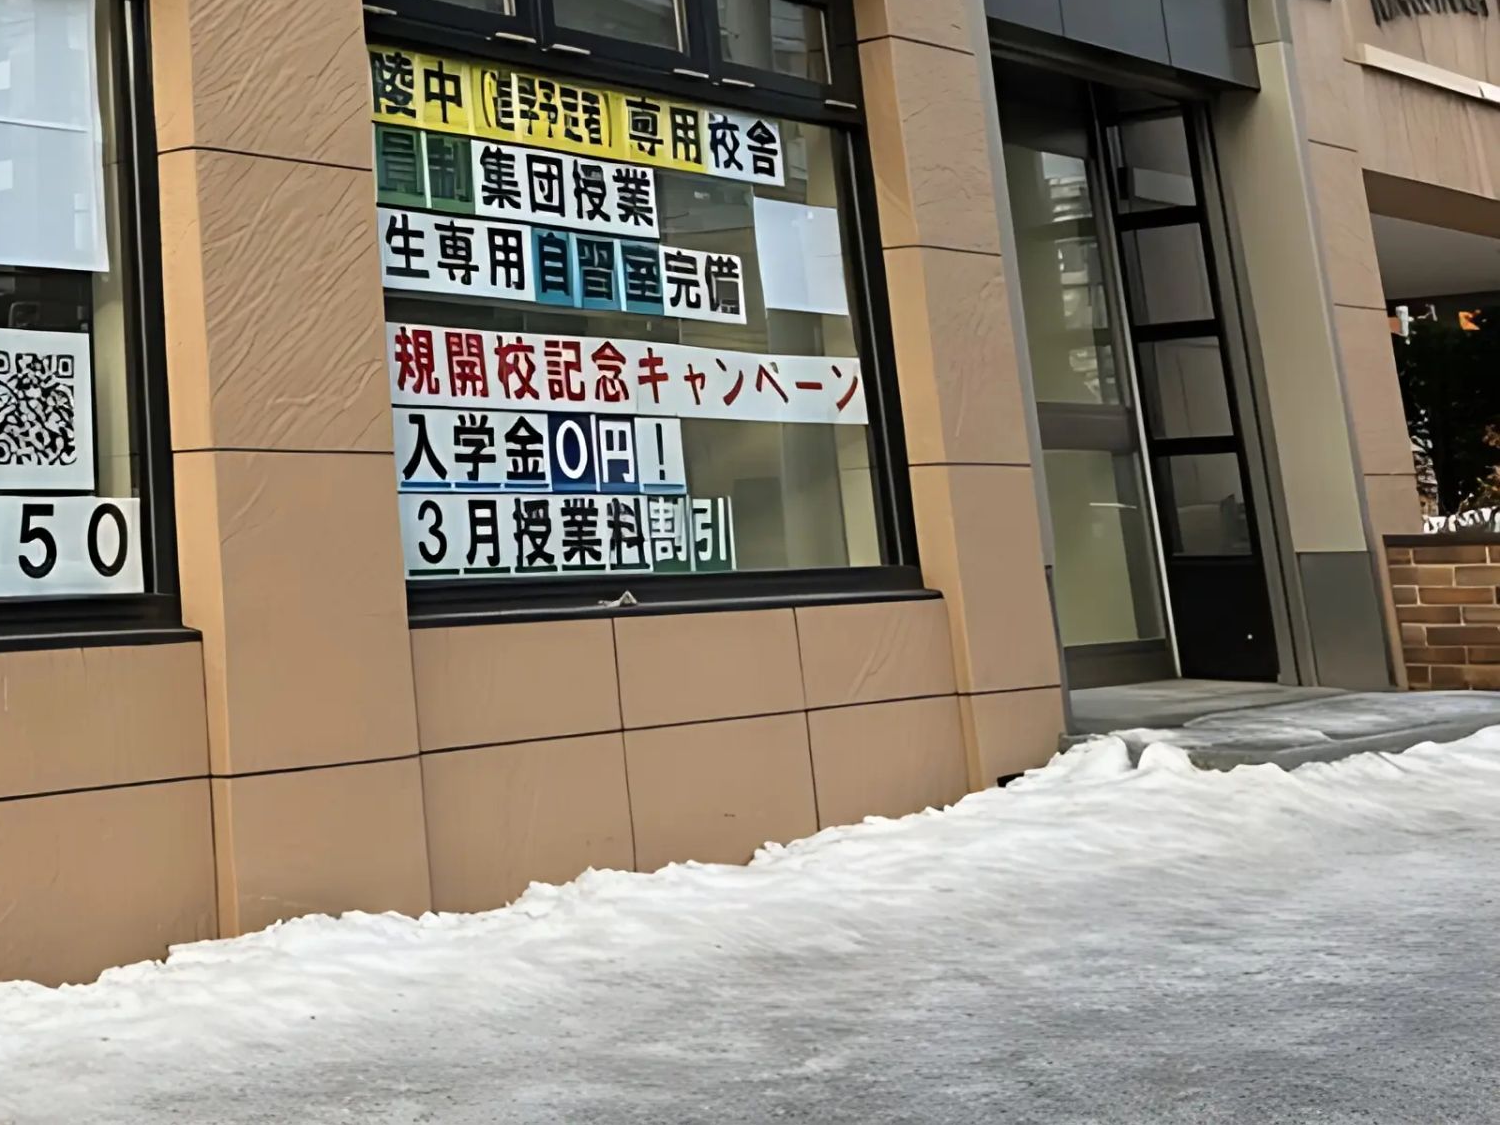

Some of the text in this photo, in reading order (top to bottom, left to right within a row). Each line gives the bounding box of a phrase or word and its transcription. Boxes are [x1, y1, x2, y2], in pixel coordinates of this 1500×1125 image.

[394, 325, 860, 412] 規開校記念キャンペーン
[402, 413, 666, 484] 入学金0円！
[418, 497, 727, 565] 3月授業料割引
